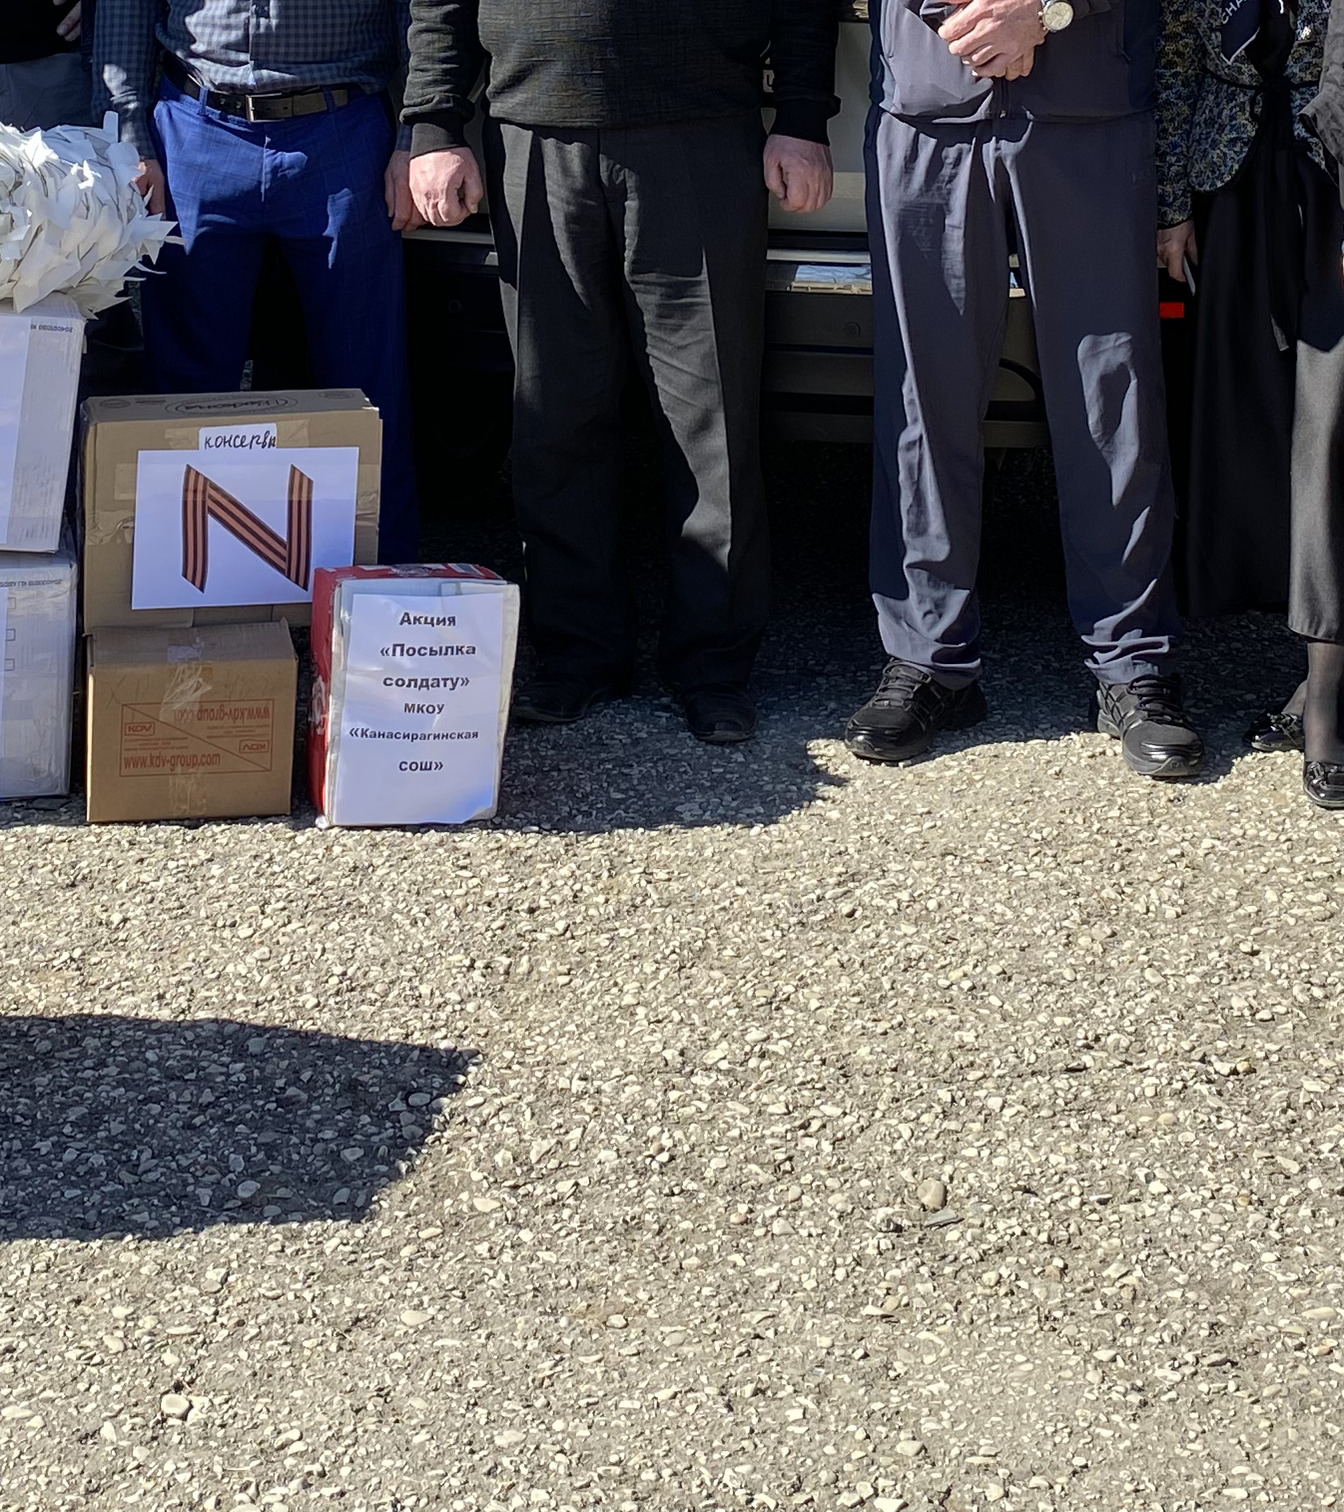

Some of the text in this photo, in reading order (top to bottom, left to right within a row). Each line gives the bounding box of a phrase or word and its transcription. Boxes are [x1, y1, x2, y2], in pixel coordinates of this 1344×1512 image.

[182, 464, 314, 594] N
[399, 612, 457, 627] Акция
[380, 643, 476, 657] «Посылка
[383, 677, 470, 691] солдату»
[404, 703, 445, 714] МКОУ
[349, 728, 479, 742] «Канасирагинская
[124, 753, 221, 771] www.kdv-group.com
